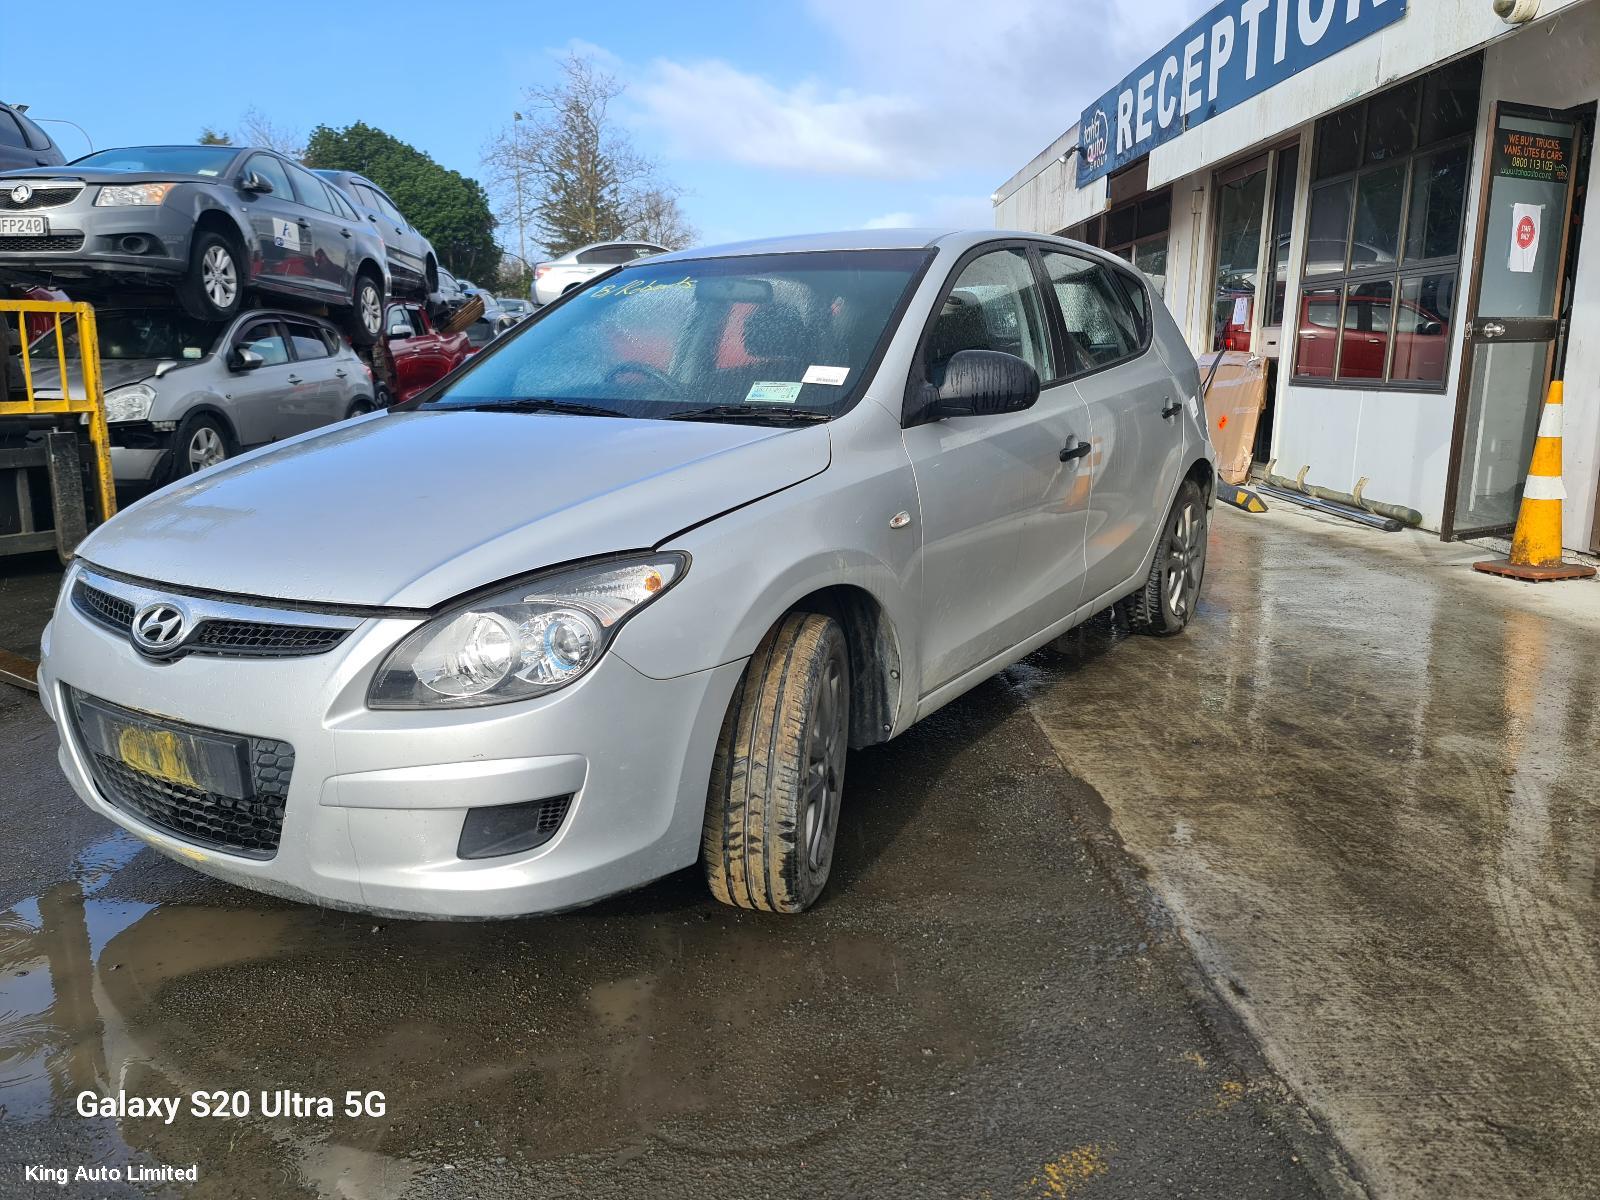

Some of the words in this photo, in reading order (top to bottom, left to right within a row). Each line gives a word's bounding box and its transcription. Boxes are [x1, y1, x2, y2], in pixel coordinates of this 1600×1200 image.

[1116, 0, 1389, 154] RECEPTIO
[1508, 134, 1520, 144] WE
[1520, 135, 1533, 146] BUY
[1523, 147, 1540, 158] UTES
[1540, 149, 1546, 158] &
[1546, 150, 1563, 161] CARS
[1511, 156, 1528, 168] 0800
[1529, 158, 1541, 170] 113
[1542, 160, 1553, 171] 103
[0, 219, 42, 233] FP240
